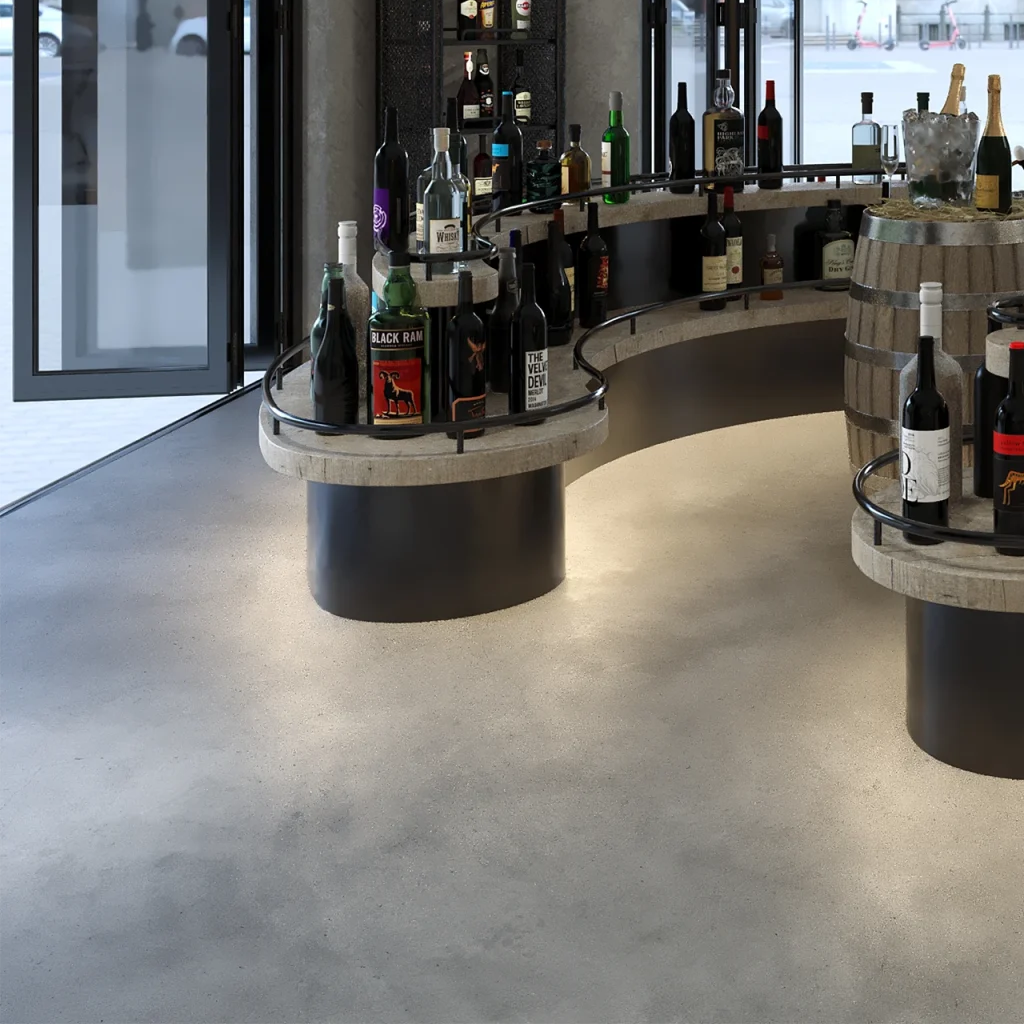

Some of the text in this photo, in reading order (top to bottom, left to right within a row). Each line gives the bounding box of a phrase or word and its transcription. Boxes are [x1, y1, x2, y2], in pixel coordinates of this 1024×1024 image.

[371, 330, 424, 344] BLACK RAM
[528, 351, 544, 363] THE
